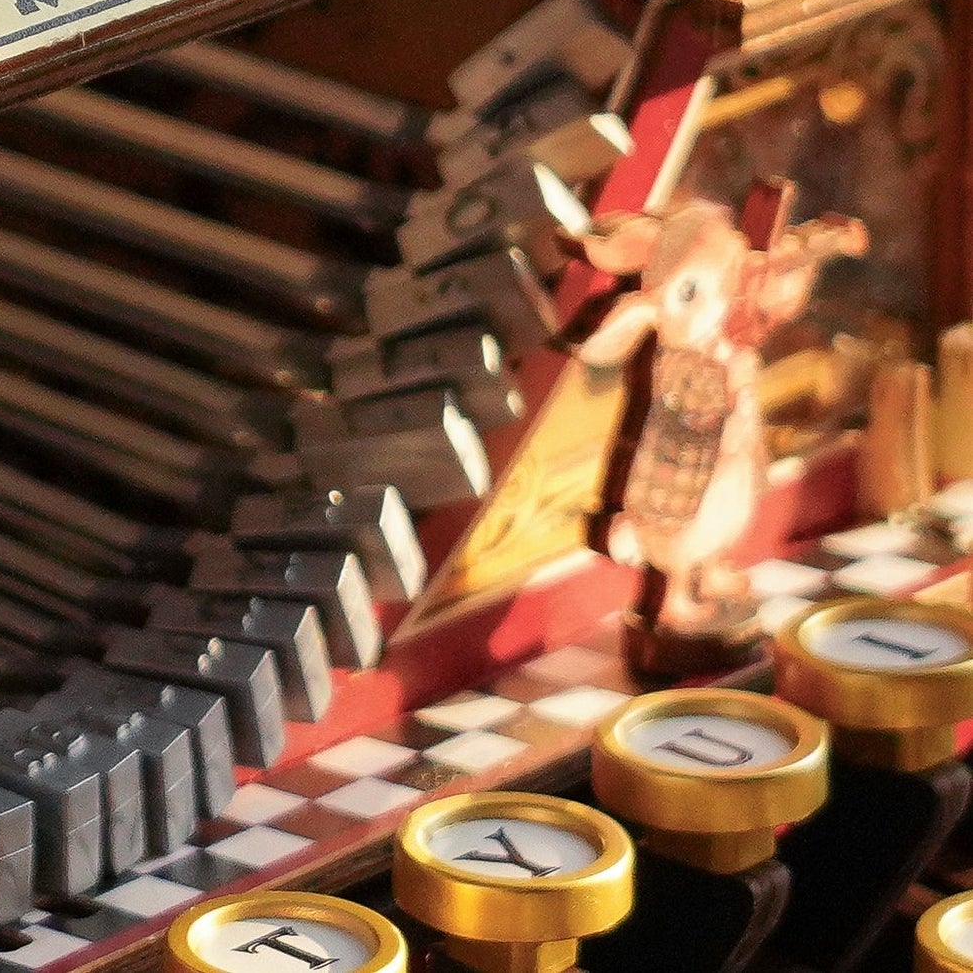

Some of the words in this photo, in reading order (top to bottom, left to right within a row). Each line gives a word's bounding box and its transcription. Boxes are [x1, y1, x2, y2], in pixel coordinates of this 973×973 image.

[852, 631, 936, 660] I
[657, 727, 754, 768] U
[454, 826, 561, 879] Y
[233, 925, 340, 971] T
